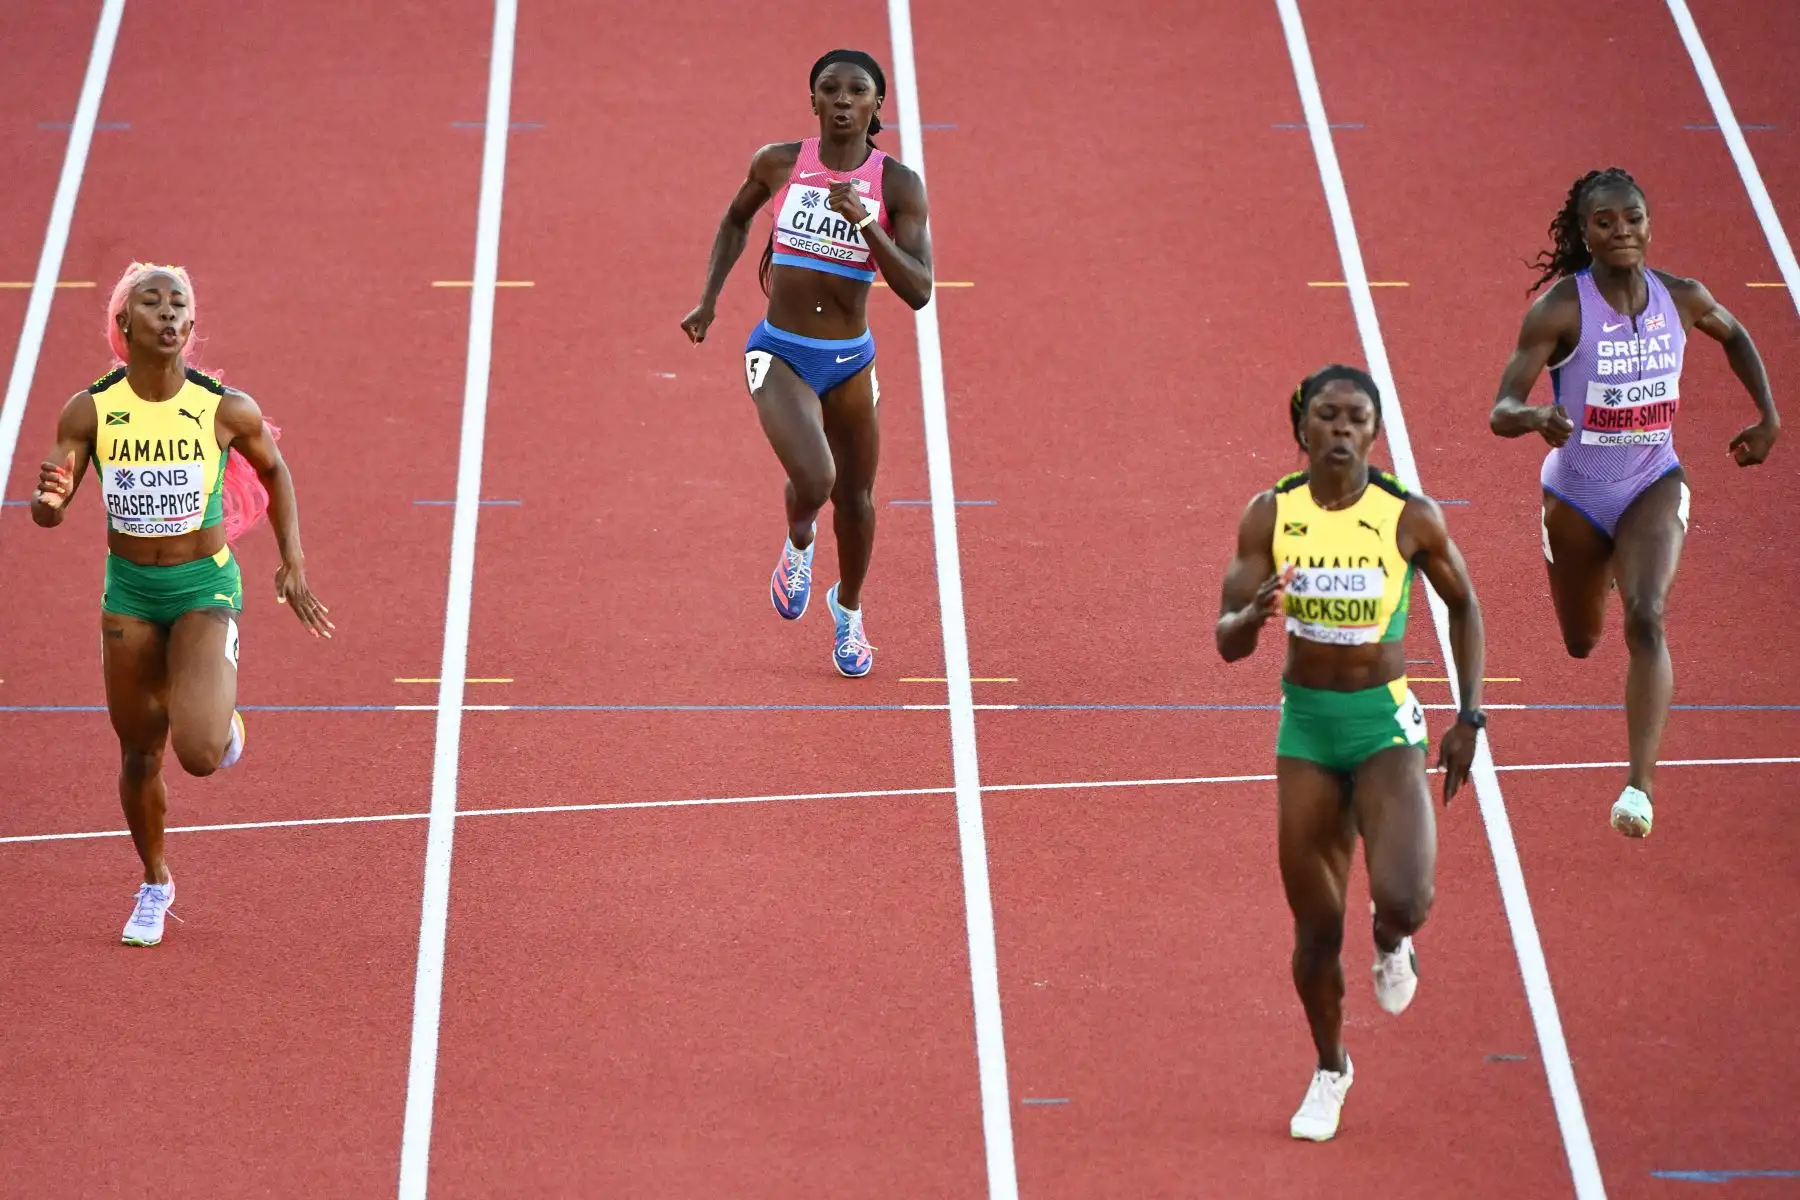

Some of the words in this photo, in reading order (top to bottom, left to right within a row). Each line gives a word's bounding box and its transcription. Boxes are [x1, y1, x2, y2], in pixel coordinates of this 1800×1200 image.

[792, 210, 860, 244] CLARK
[789, 237, 854, 260] OREGON22
[1597, 333, 1671, 357] GREAT
[749, 358, 760, 384] 5
[1597, 352, 1676, 375] BRITAIN
[1627, 381, 1667, 402] QNB
[1588, 402, 1676, 429] ASHER-SMITH
[108, 438, 205, 462] JAMAICA
[1598, 432, 1666, 445] OREGON22
[140, 469, 188, 487] QNB
[107, 491, 200, 516] FRASER-PRYCE
[123, 521, 188, 534] OREGON22
[1315, 574, 1366, 592] QNB
